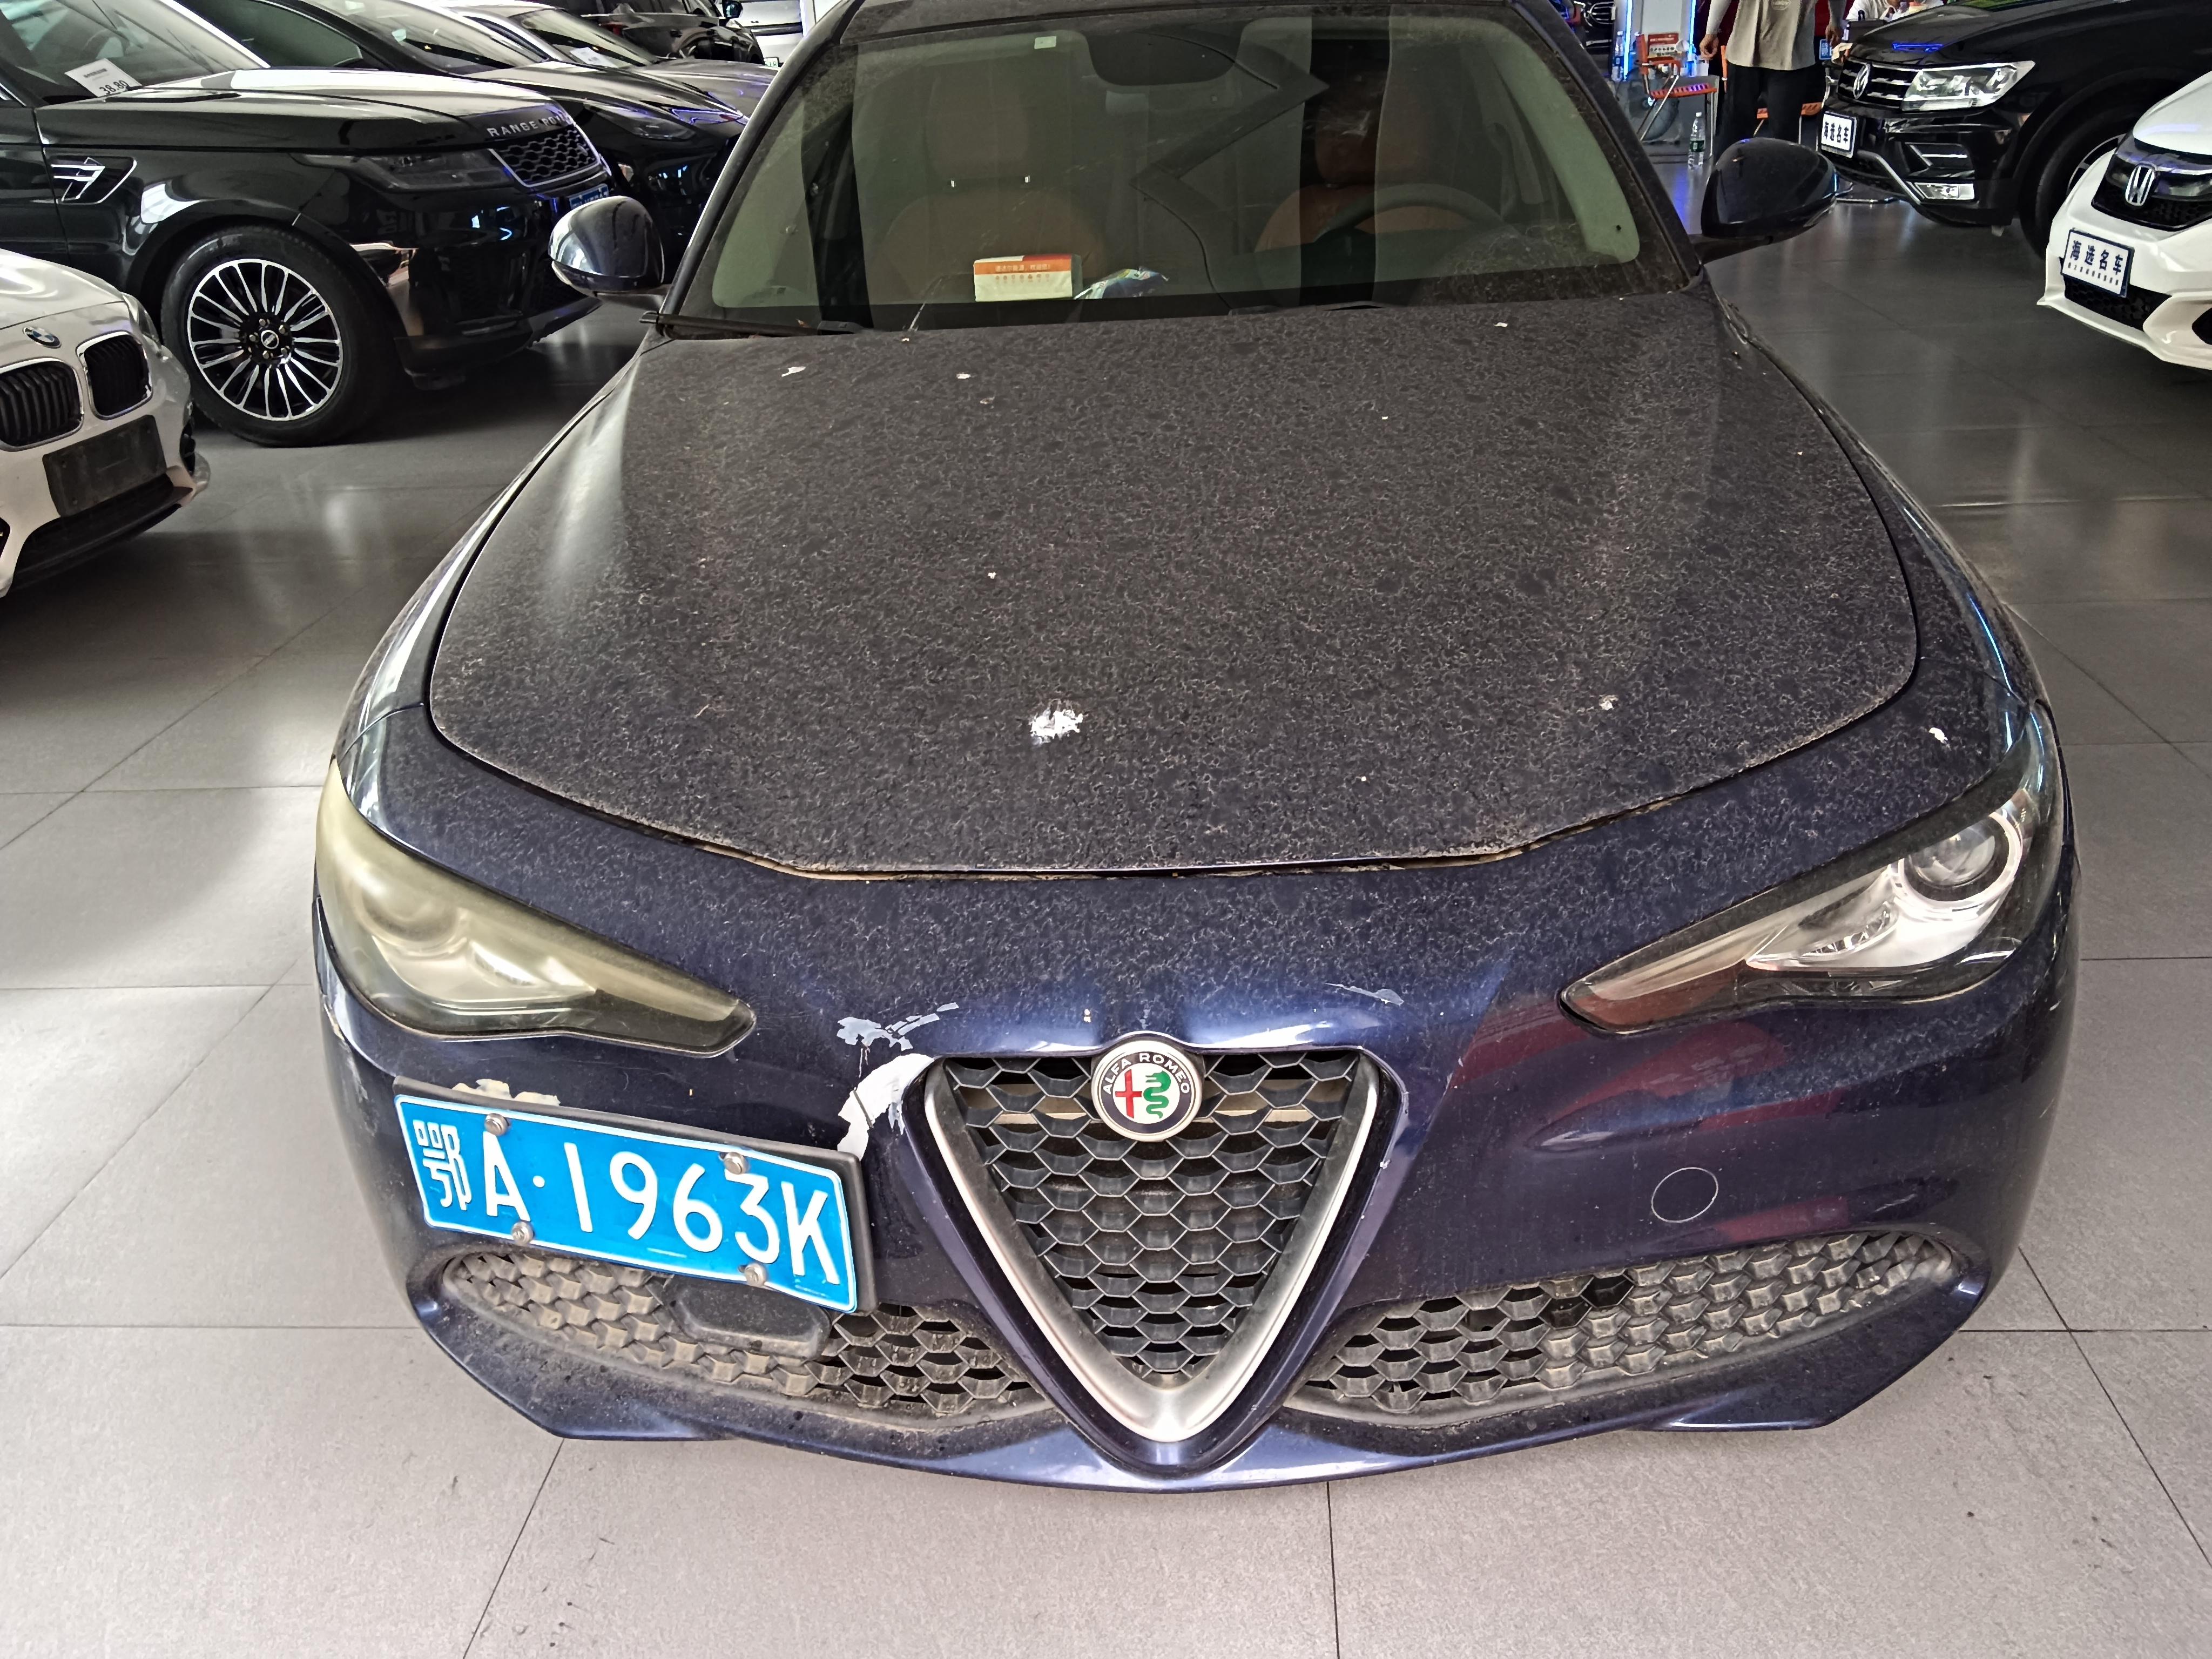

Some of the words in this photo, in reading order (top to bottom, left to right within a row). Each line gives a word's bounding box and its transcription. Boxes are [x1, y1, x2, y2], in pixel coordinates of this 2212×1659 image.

[99, 80, 129, 95] 38.80
[487, 121, 538, 137] RANGE
[2070, 240, 2123, 275] 海选名车
[1103, 1058, 1132, 1095] ALFA
[1139, 1053, 1190, 1094] ROMEO
